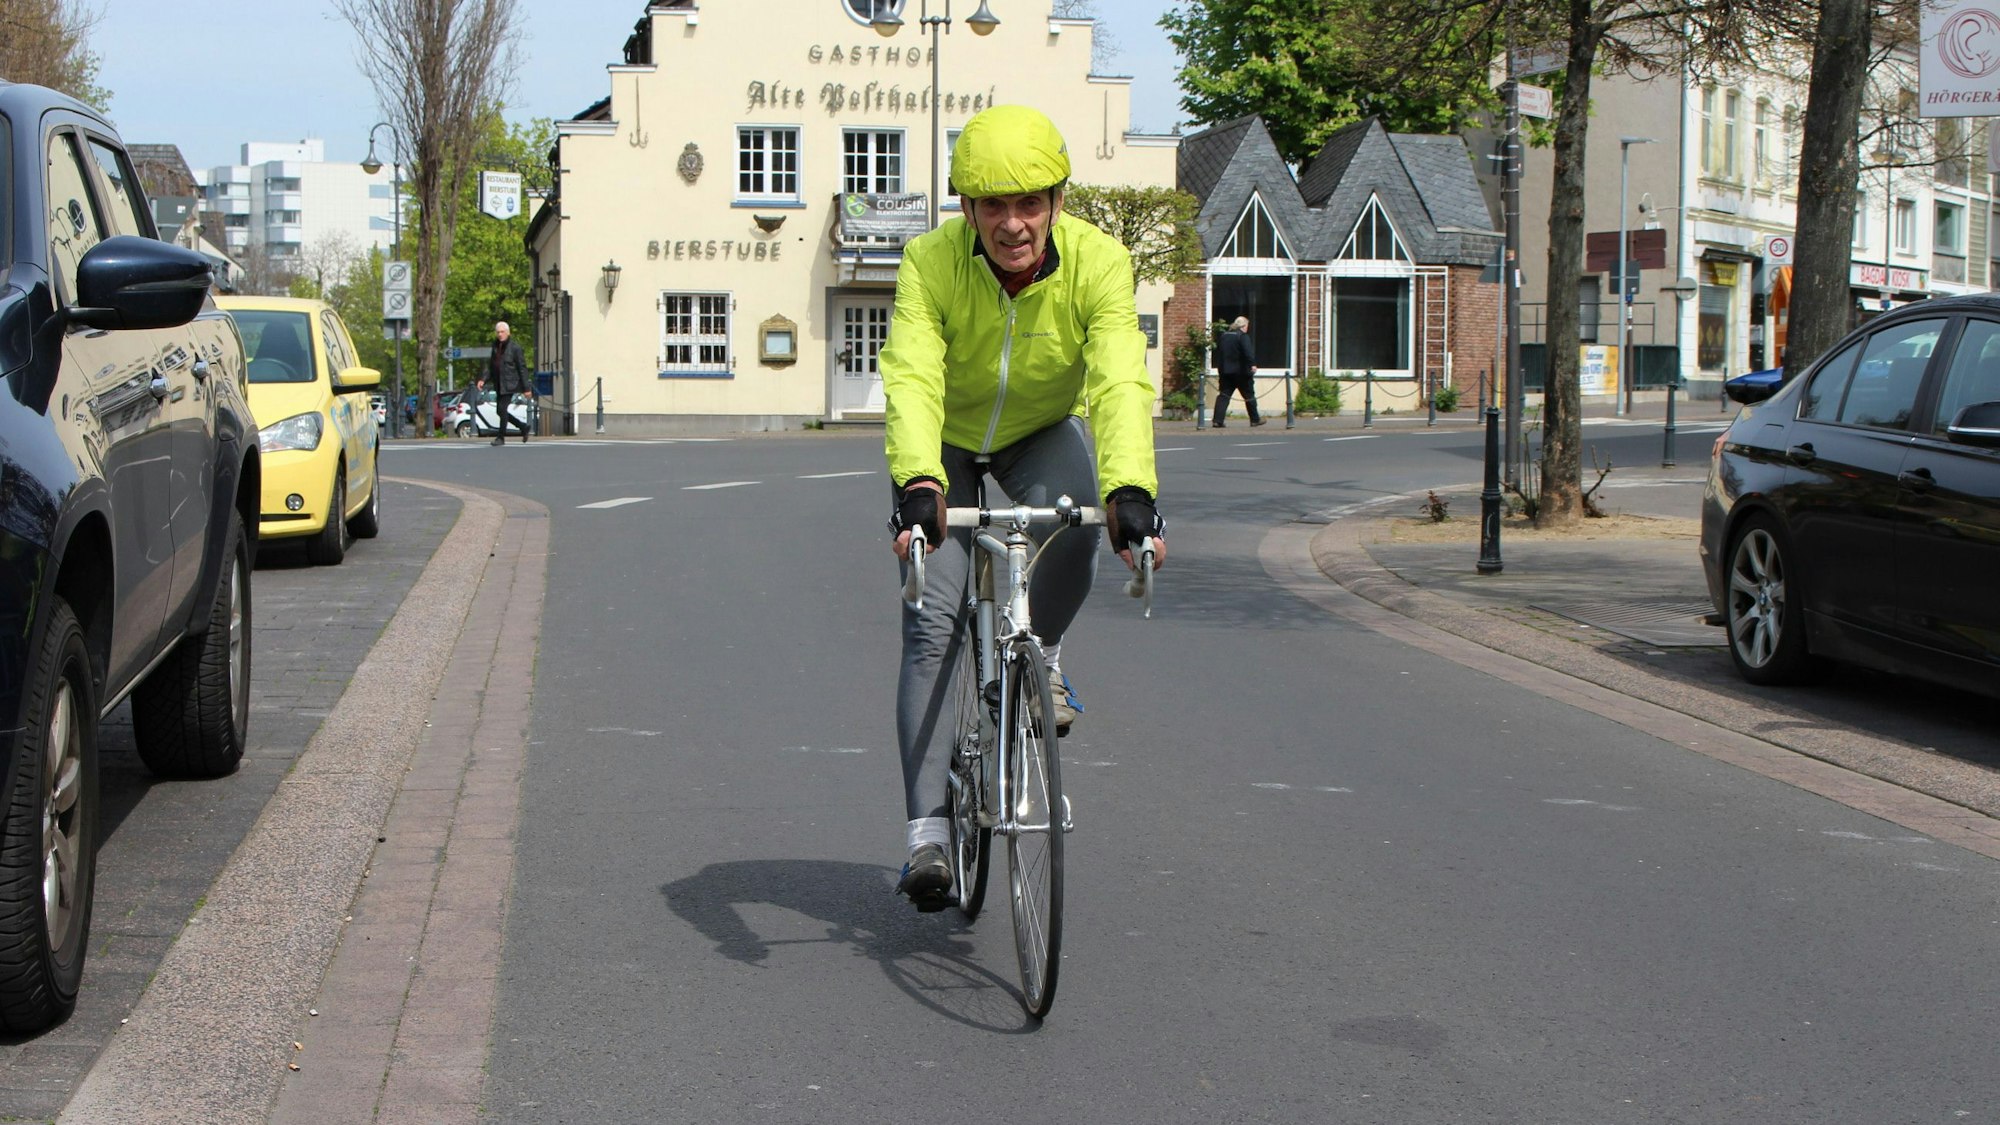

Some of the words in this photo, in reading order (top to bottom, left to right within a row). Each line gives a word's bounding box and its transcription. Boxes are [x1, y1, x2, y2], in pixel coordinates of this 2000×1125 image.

[808, 44, 935, 65] GASTHOF
[746, 80, 805, 112] Alte
[487, 175, 520, 184] RESTAURANT
[489, 186, 517, 194] BIERSTUBE
[876, 199, 927, 211] COUSIN
[646, 239, 781, 260] BIERSTUBE
[1773, 243, 1785, 252] 30
[1861, 265, 1888, 285] BAGDA
[1892, 269, 1911, 288] KIOSK
